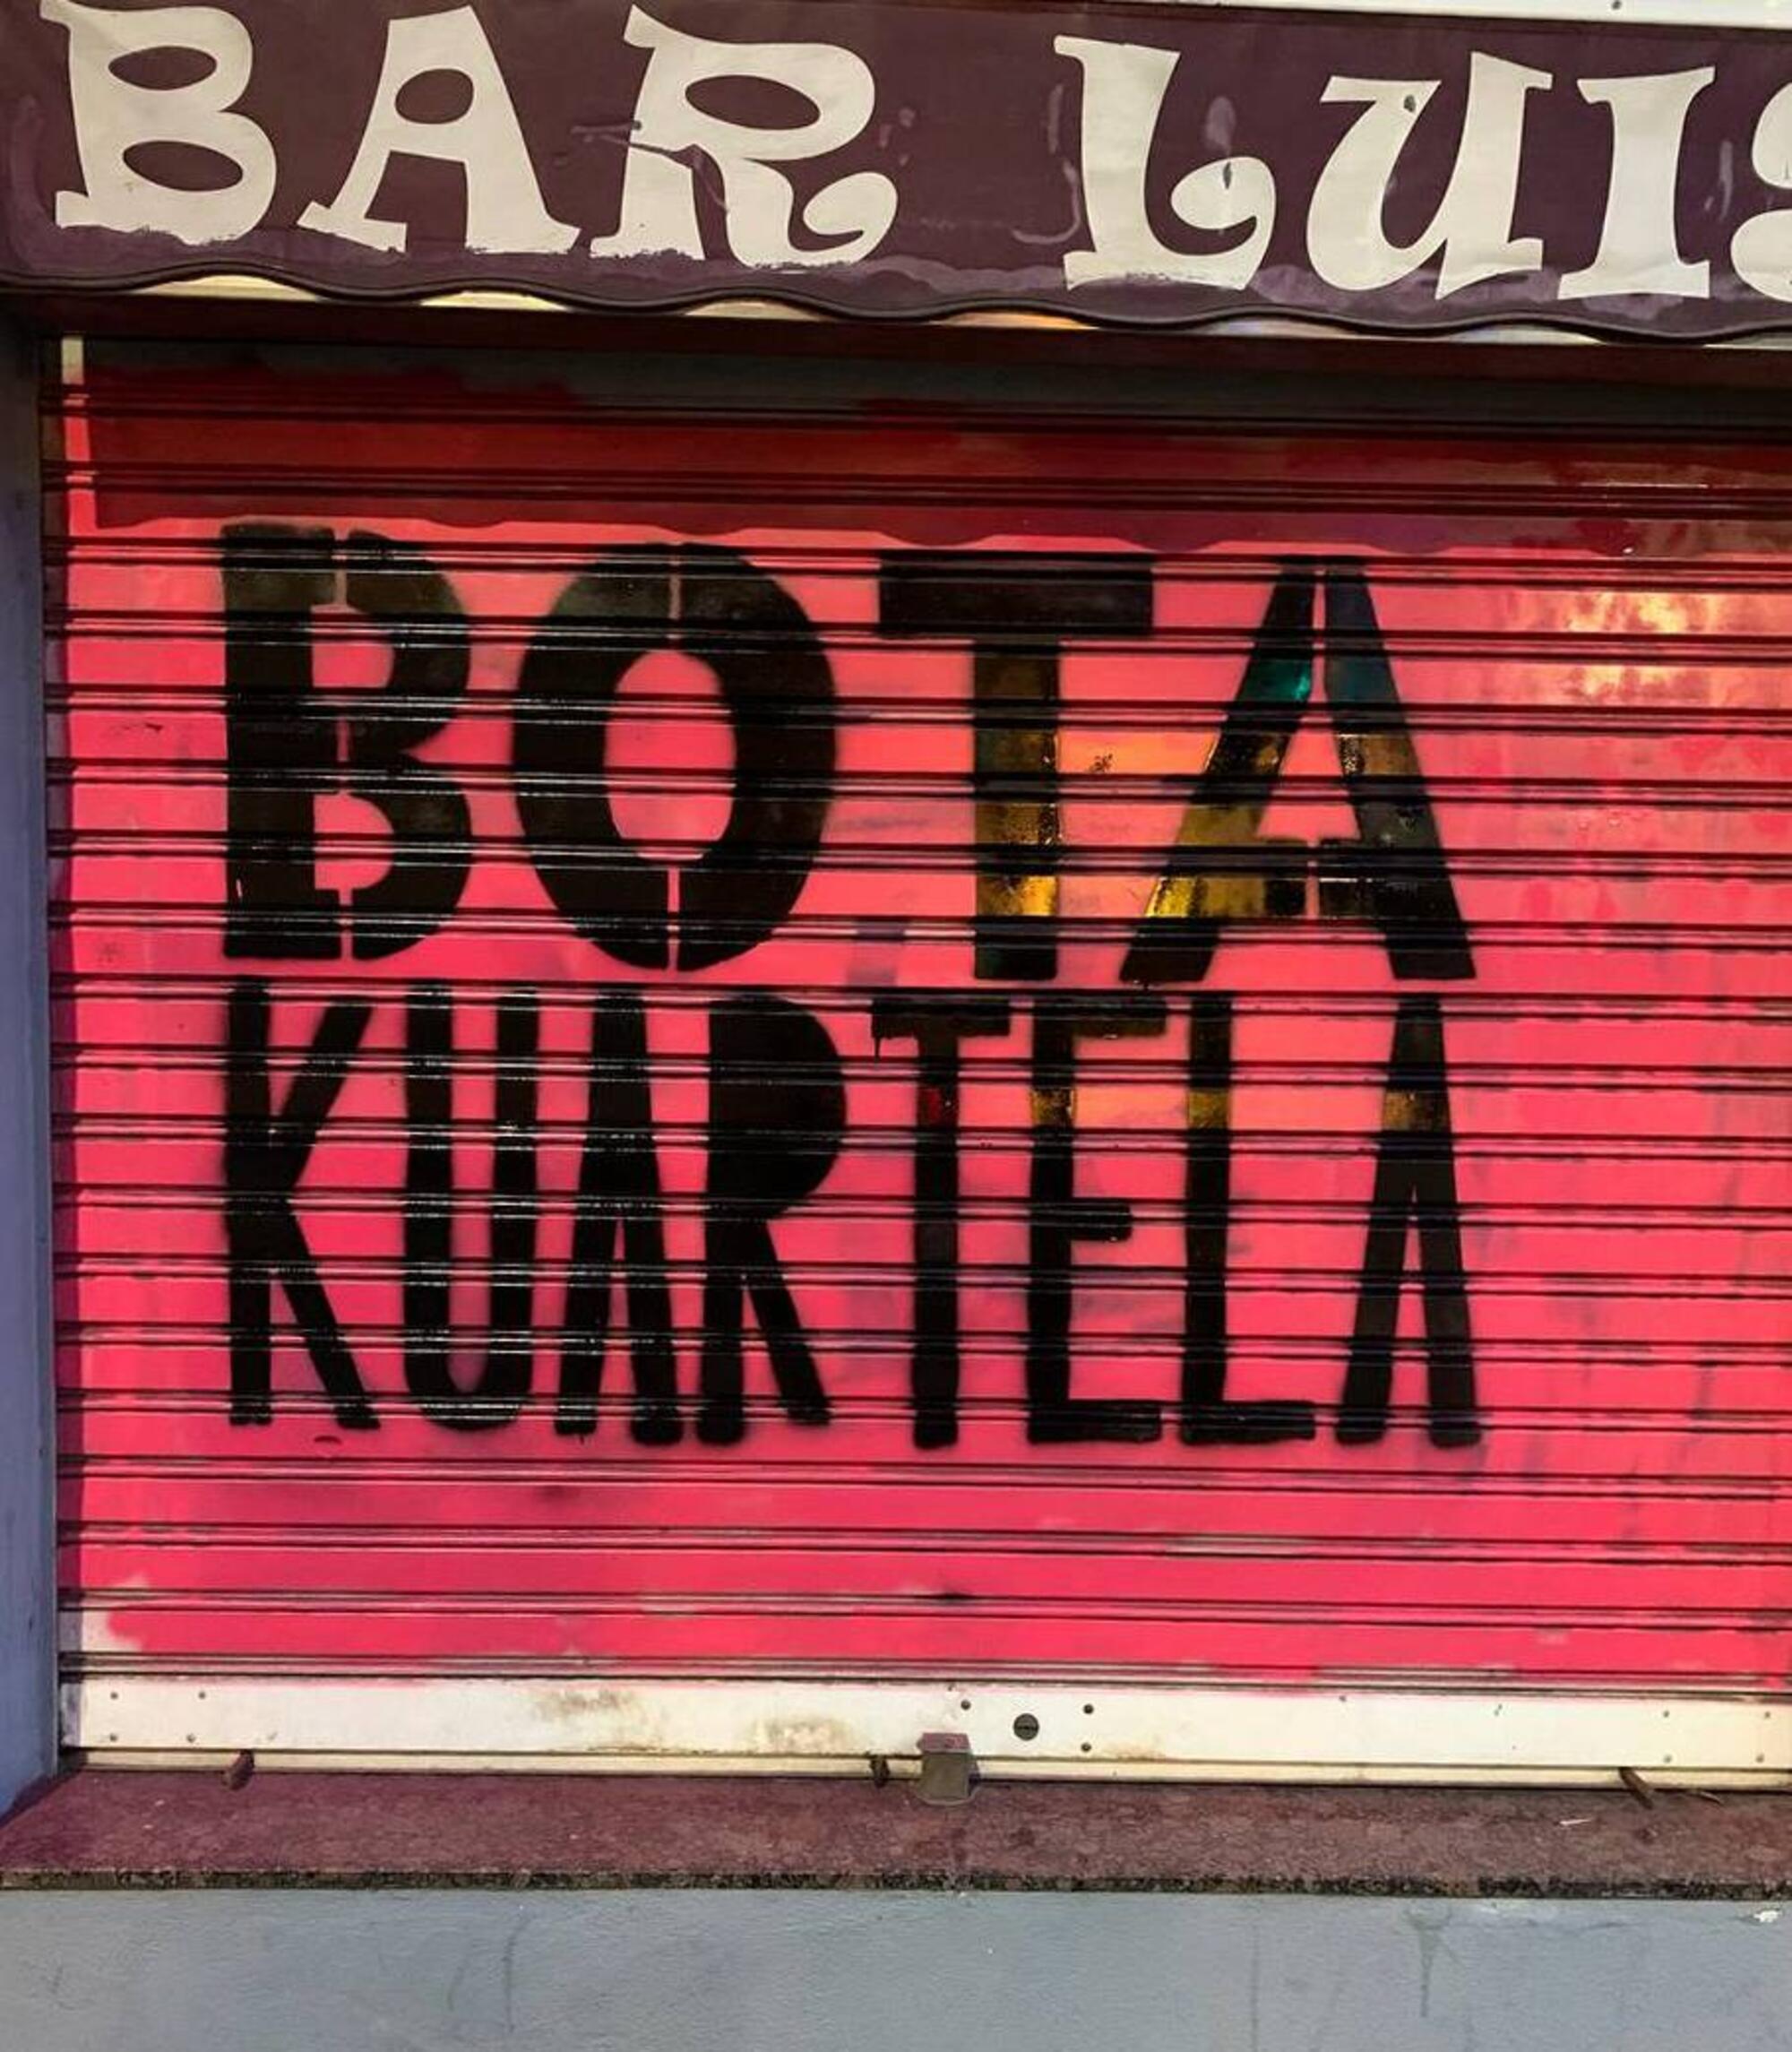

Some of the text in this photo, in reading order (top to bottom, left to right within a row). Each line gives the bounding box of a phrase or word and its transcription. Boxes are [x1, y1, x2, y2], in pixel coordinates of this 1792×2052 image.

[40, 0, 899, 268] BAR
[220, 523, 1477, 982] BOTA
[223, 979, 1483, 1448] KUARTELA
